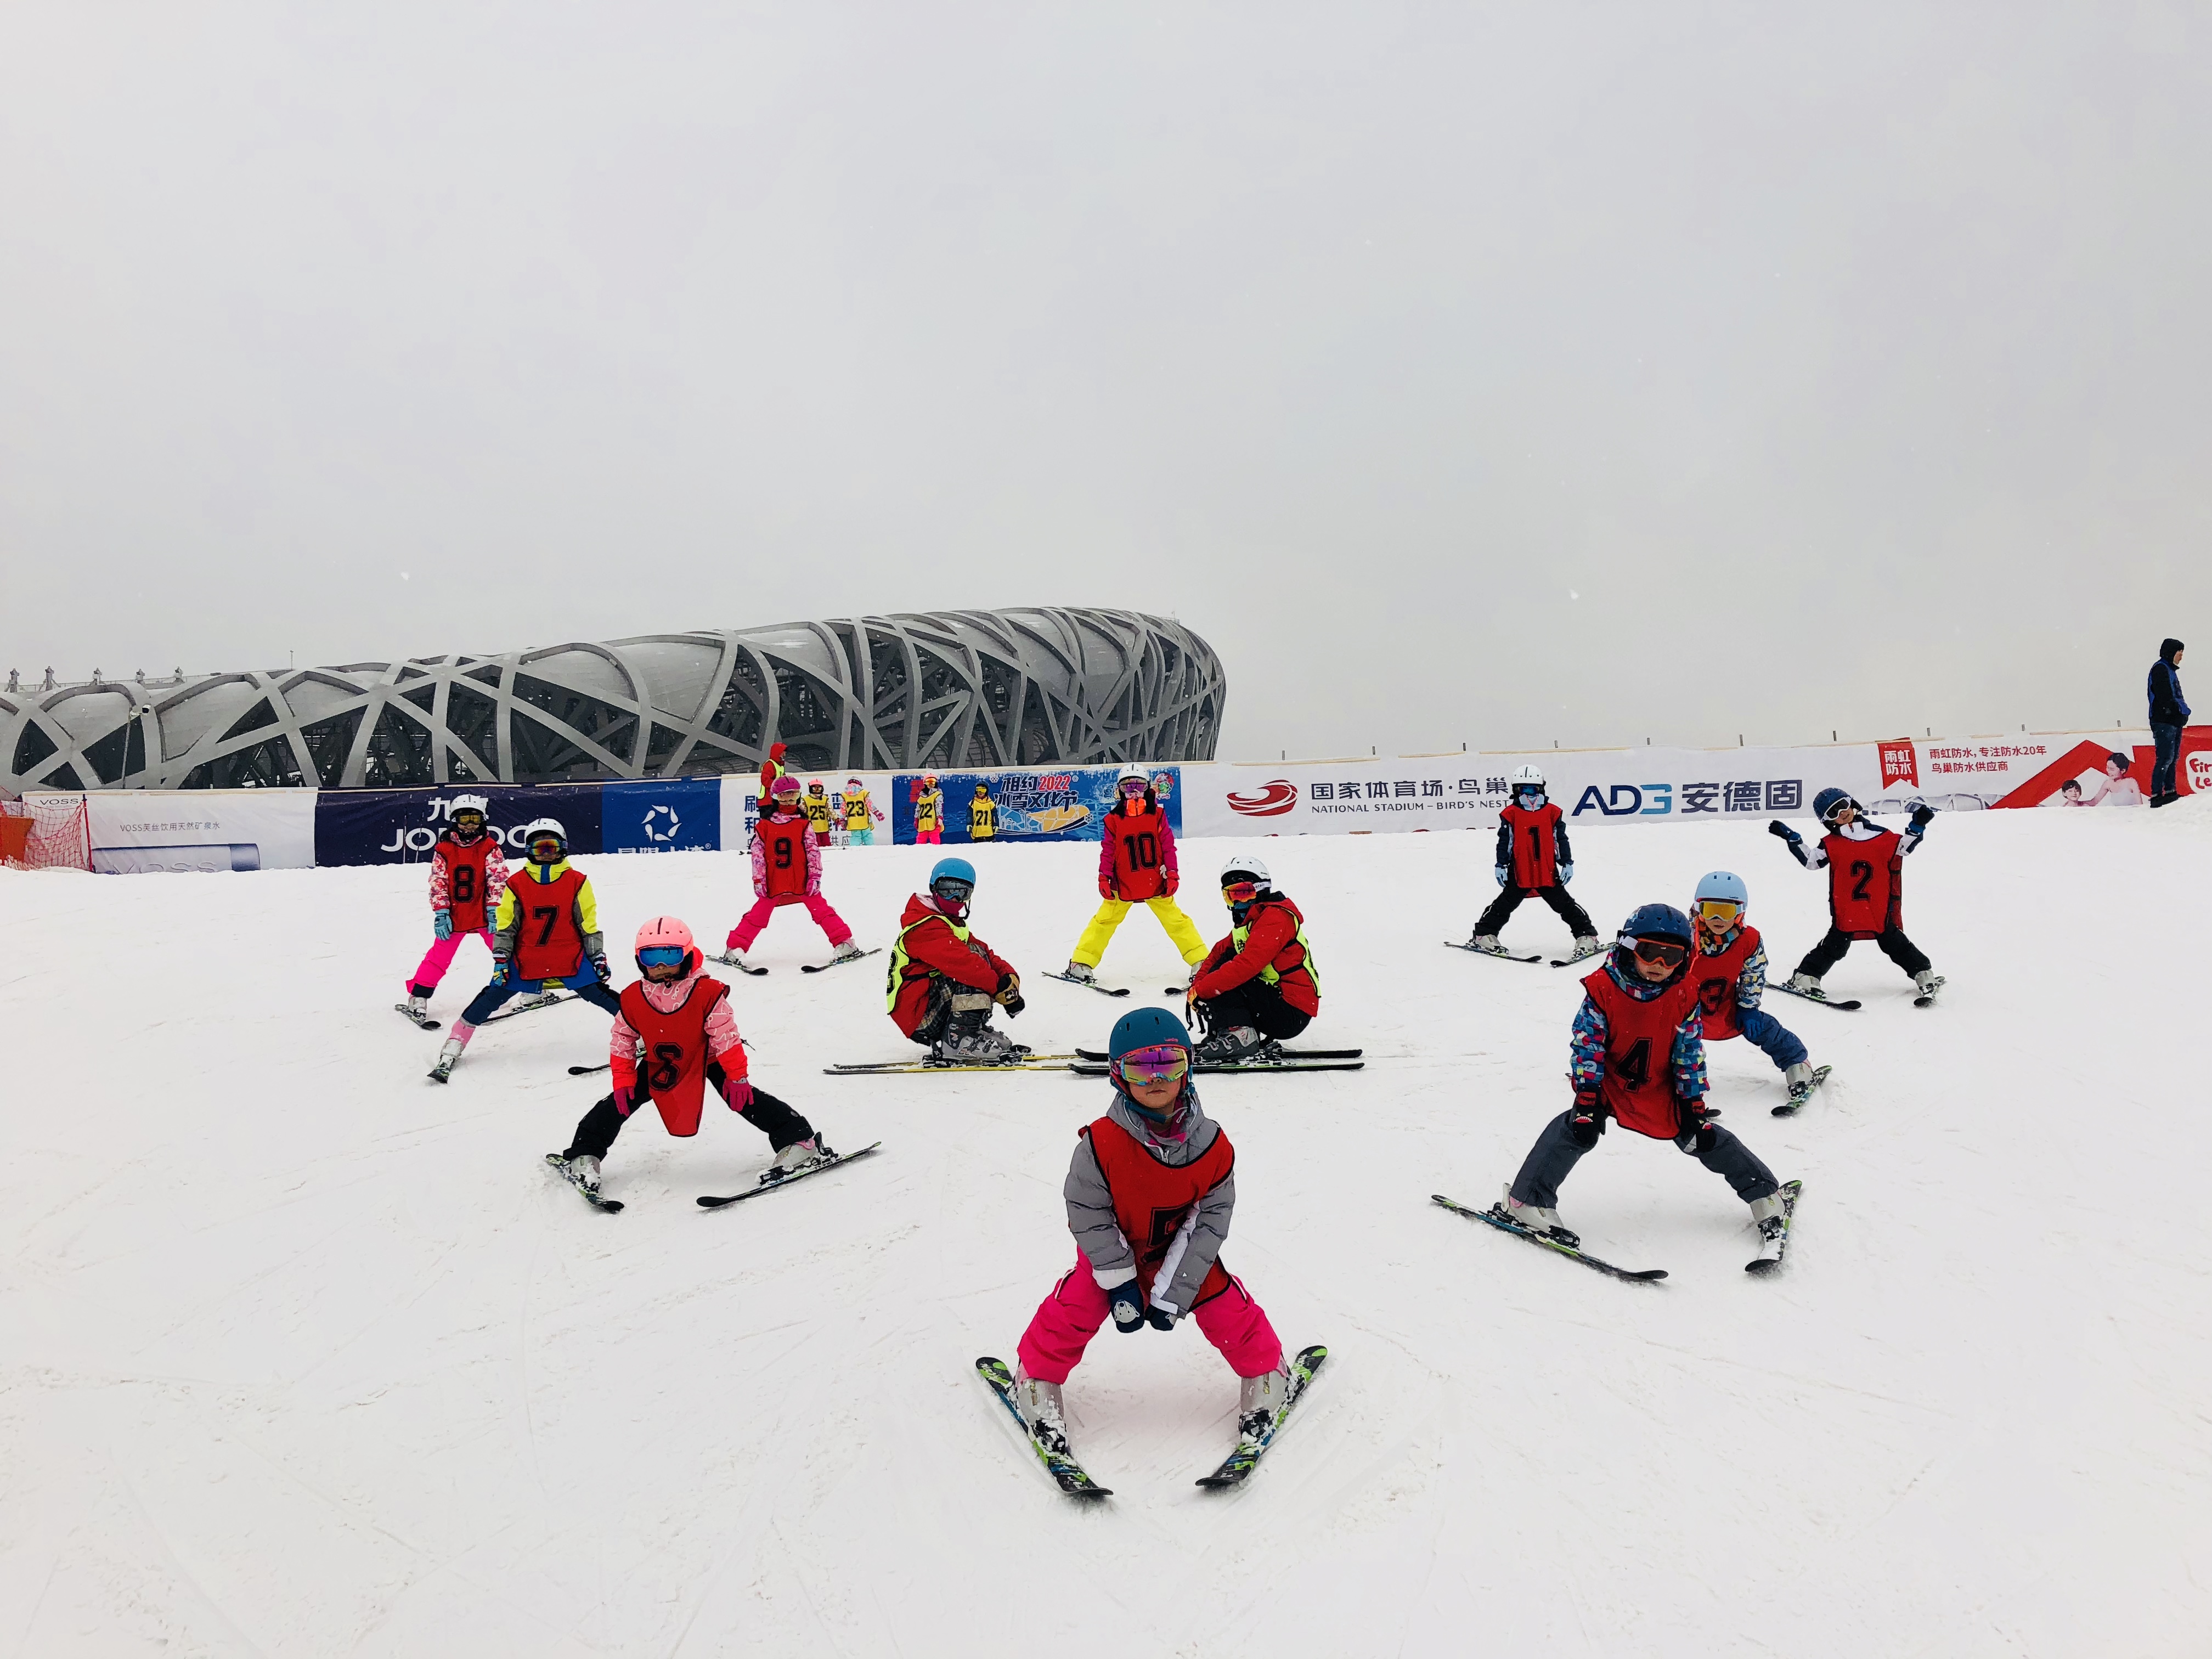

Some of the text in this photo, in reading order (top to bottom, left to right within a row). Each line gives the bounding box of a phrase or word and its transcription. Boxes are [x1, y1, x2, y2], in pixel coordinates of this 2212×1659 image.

[1884, 749, 1910, 763] 雨虹
[1932, 761, 2008, 774] 鸟巢防水供应商
[1886, 763, 1912, 776] 防水
[1001, 775, 1071, 792] 相约2022
[1311, 777, 1509, 800] 国家体育场·鸟巢
[994, 790, 1079, 814] 冰雪文化节
[1312, 804, 1369, 814] NATIONAL
[1374, 803, 1424, 812] STADIUM
[1437, 800, 1475, 810] BIRD'S
[1480, 799, 1509, 809] NEST
[1681, 779, 1803, 814] 安德固
[809, 805, 826, 820] 25
[847, 800, 865, 817] 23
[919, 803, 933, 820] 22
[975, 810, 988, 826] 21
[774, 837, 792, 869] 9
[1123, 832, 1158, 873] 10
[1528, 825, 1541, 861] 1
[453, 864, 475, 903] 8
[1850, 859, 1874, 901] 2
[533, 905, 560, 947] 7
[1699, 976, 1729, 1017] 3
[1613, 1036, 1652, 1094] 4
